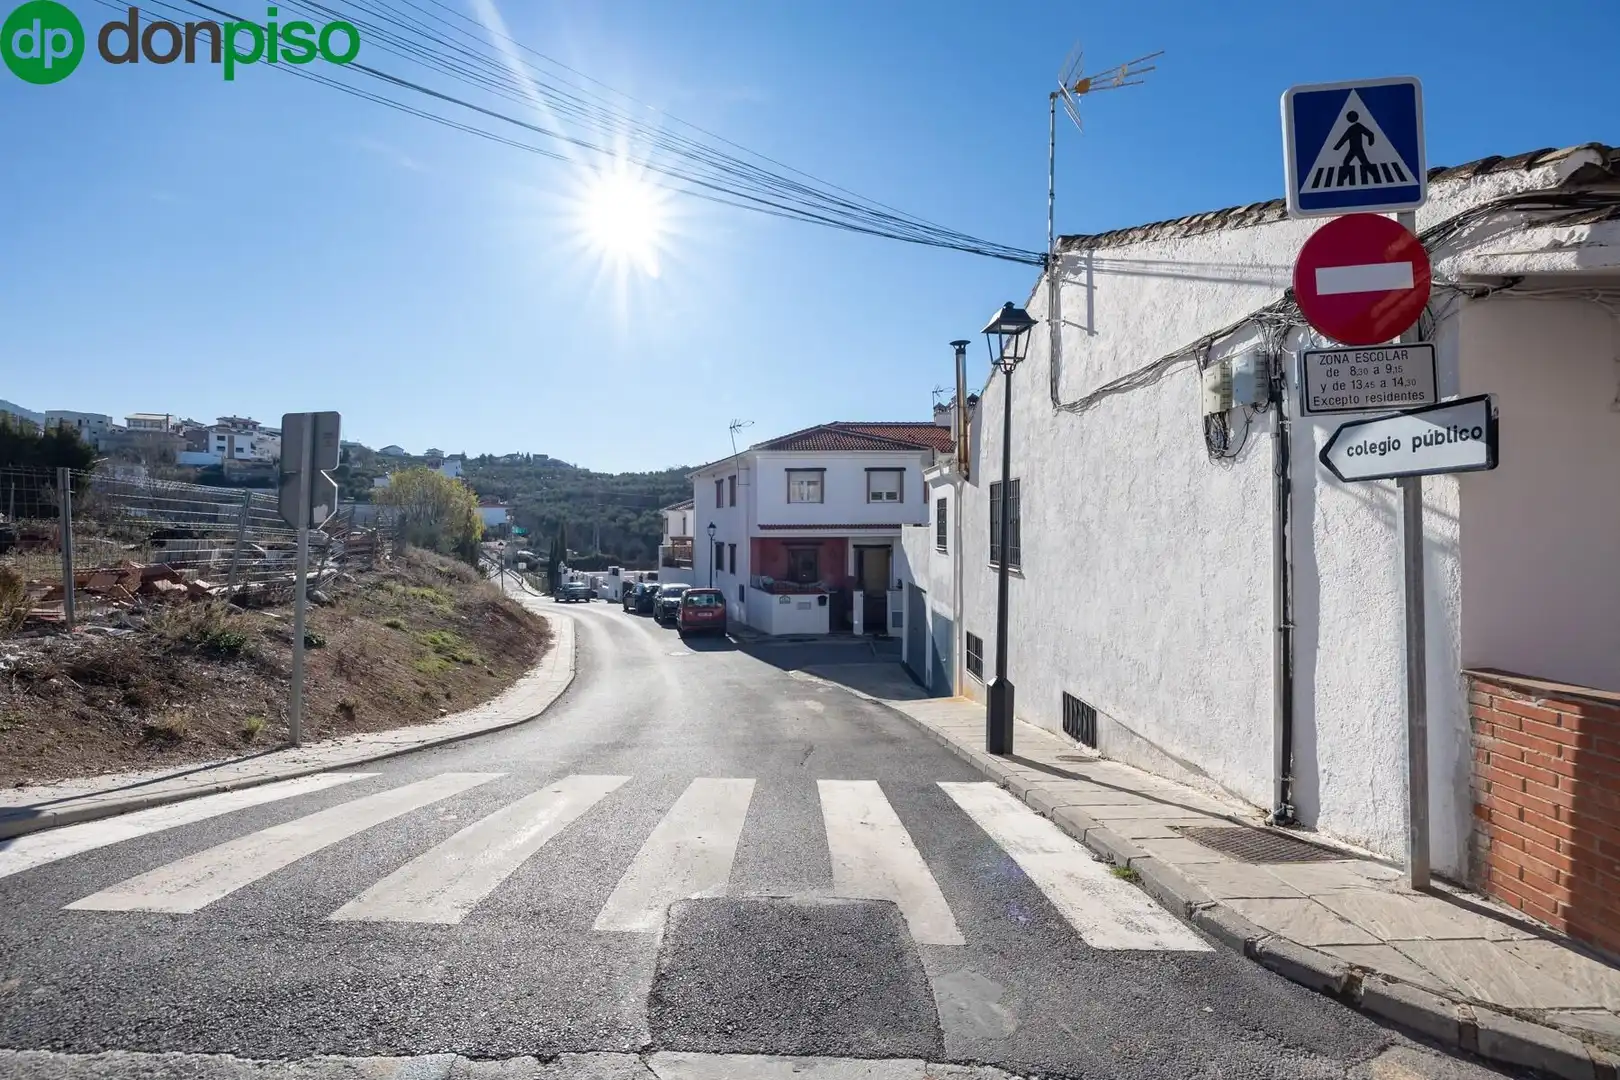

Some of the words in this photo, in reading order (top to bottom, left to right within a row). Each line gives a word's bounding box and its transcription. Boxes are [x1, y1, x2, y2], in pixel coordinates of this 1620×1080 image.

[1319, 353, 1350, 366] ZONA
[1355, 349, 1409, 363] ESCOLAR
[1326, 367, 1340, 378] de
[1373, 366, 1380, 375] a
[1320, 383, 1327, 394] y
[1332, 381, 1346, 391] de
[1380, 380, 1387, 388] a
[1313, 394, 1360, 407] Excepto
[1365, 390, 1425, 403] residentes
[1346, 436, 1401, 457] colegio
[1412, 424, 1483, 453] público
